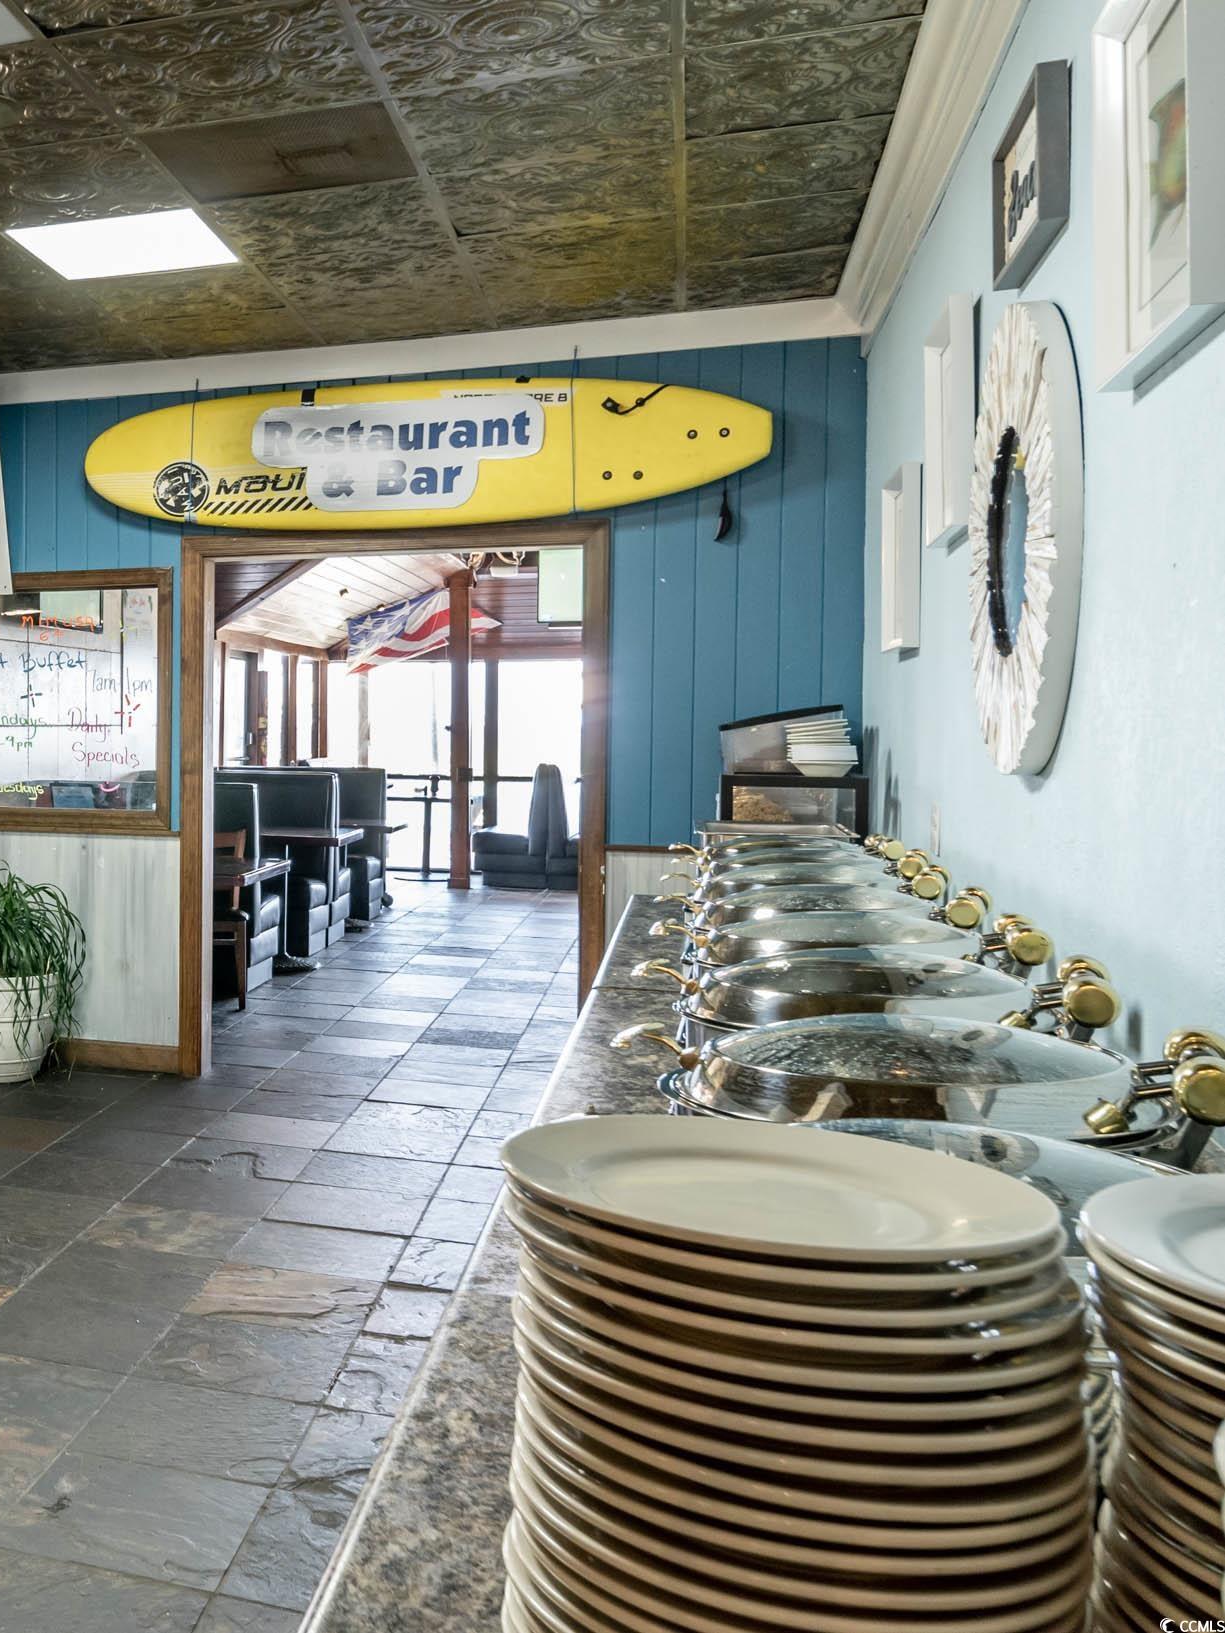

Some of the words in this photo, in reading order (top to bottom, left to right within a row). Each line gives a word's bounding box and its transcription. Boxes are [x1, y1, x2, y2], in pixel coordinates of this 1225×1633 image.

[263, 410, 531, 457] Restaurant
[321, 461, 355, 498] &
[376, 459, 463, 497] Bar
[20, 650, 88, 674] Buffet
[71, 741, 140, 769] Specials
